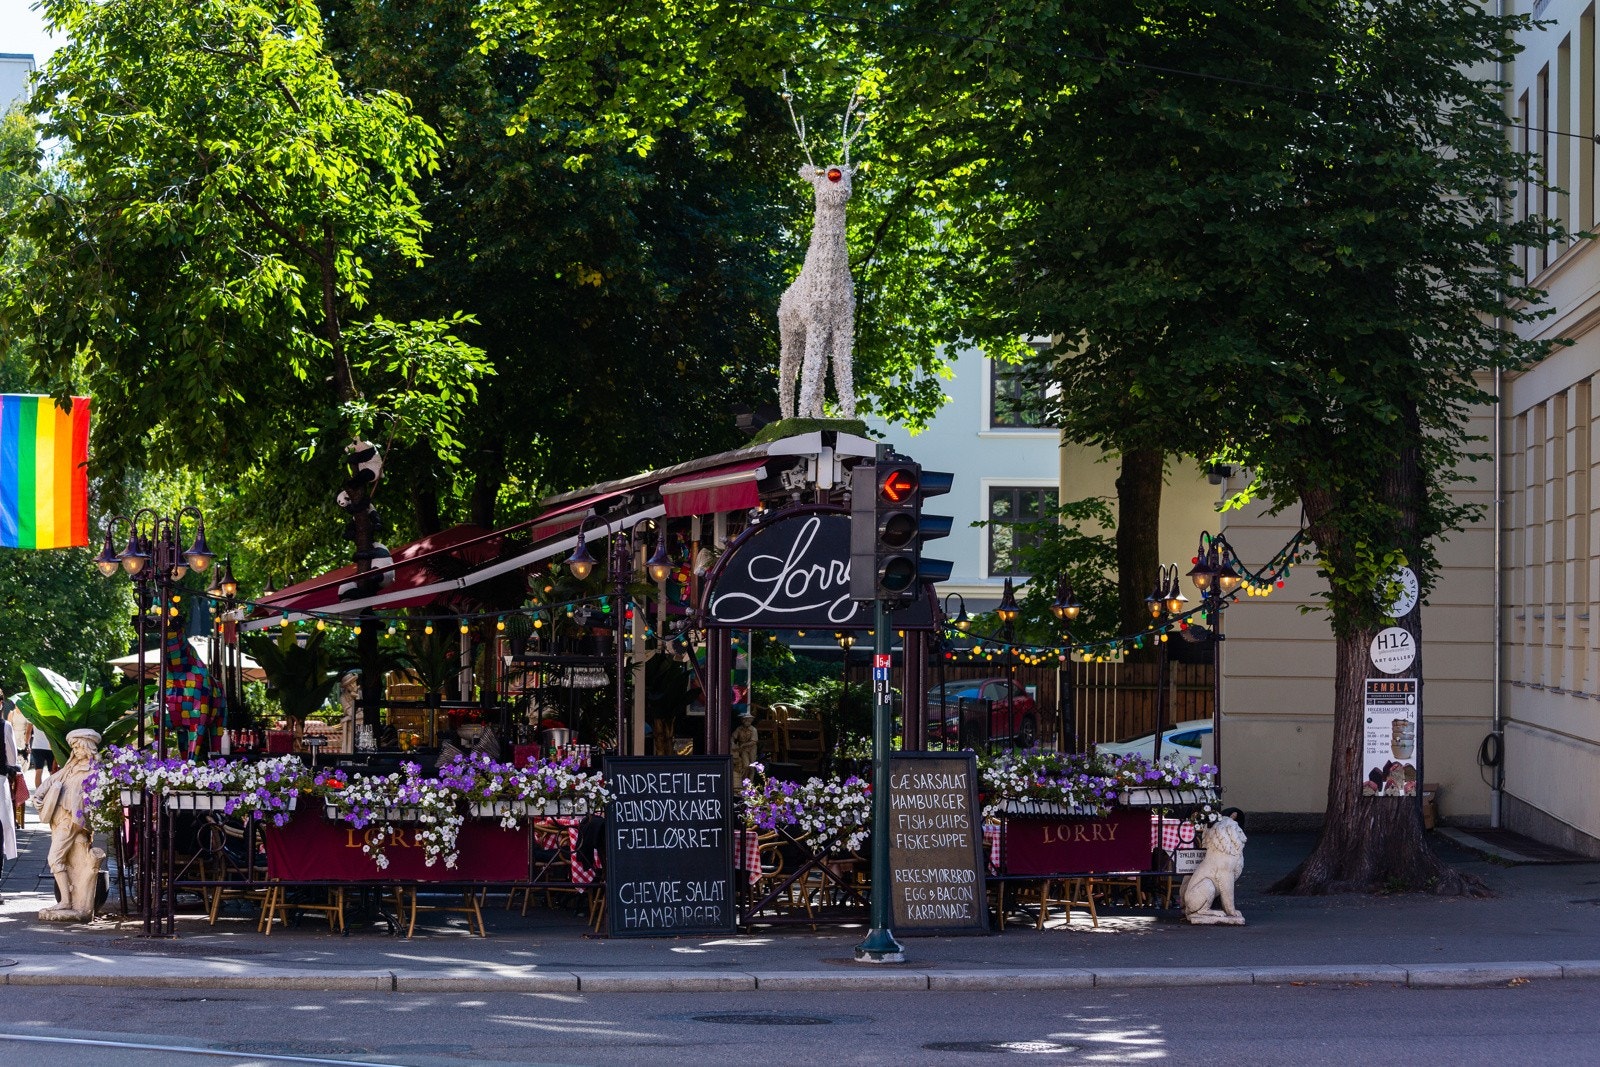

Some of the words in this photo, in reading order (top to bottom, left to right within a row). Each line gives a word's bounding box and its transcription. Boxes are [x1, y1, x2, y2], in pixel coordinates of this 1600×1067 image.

[1377, 631, 1410, 650] H12
[1388, 654, 1415, 662] GALLERY
[1373, 682, 1409, 692] EMBLA
[1406, 711, 1414, 719] 14
[617, 773, 721, 794] INDREFILET
[891, 793, 966, 810] HAMBURGER
[615, 799, 722, 823] REINSDYRKAKER
[898, 814, 927, 830] FISH
[935, 814, 969, 829] CHIPS
[345, 827, 430, 848] LOR
[617, 827, 722, 850] FJELLØRRET
[1042, 823, 1119, 844] LORRY
[619, 881, 682, 904] CHEVRE
[686, 880, 726, 902] SALAT
[904, 887, 927, 901] EGG
[937, 885, 973, 901] BACON
[907, 903, 971, 920] KARBONADE
